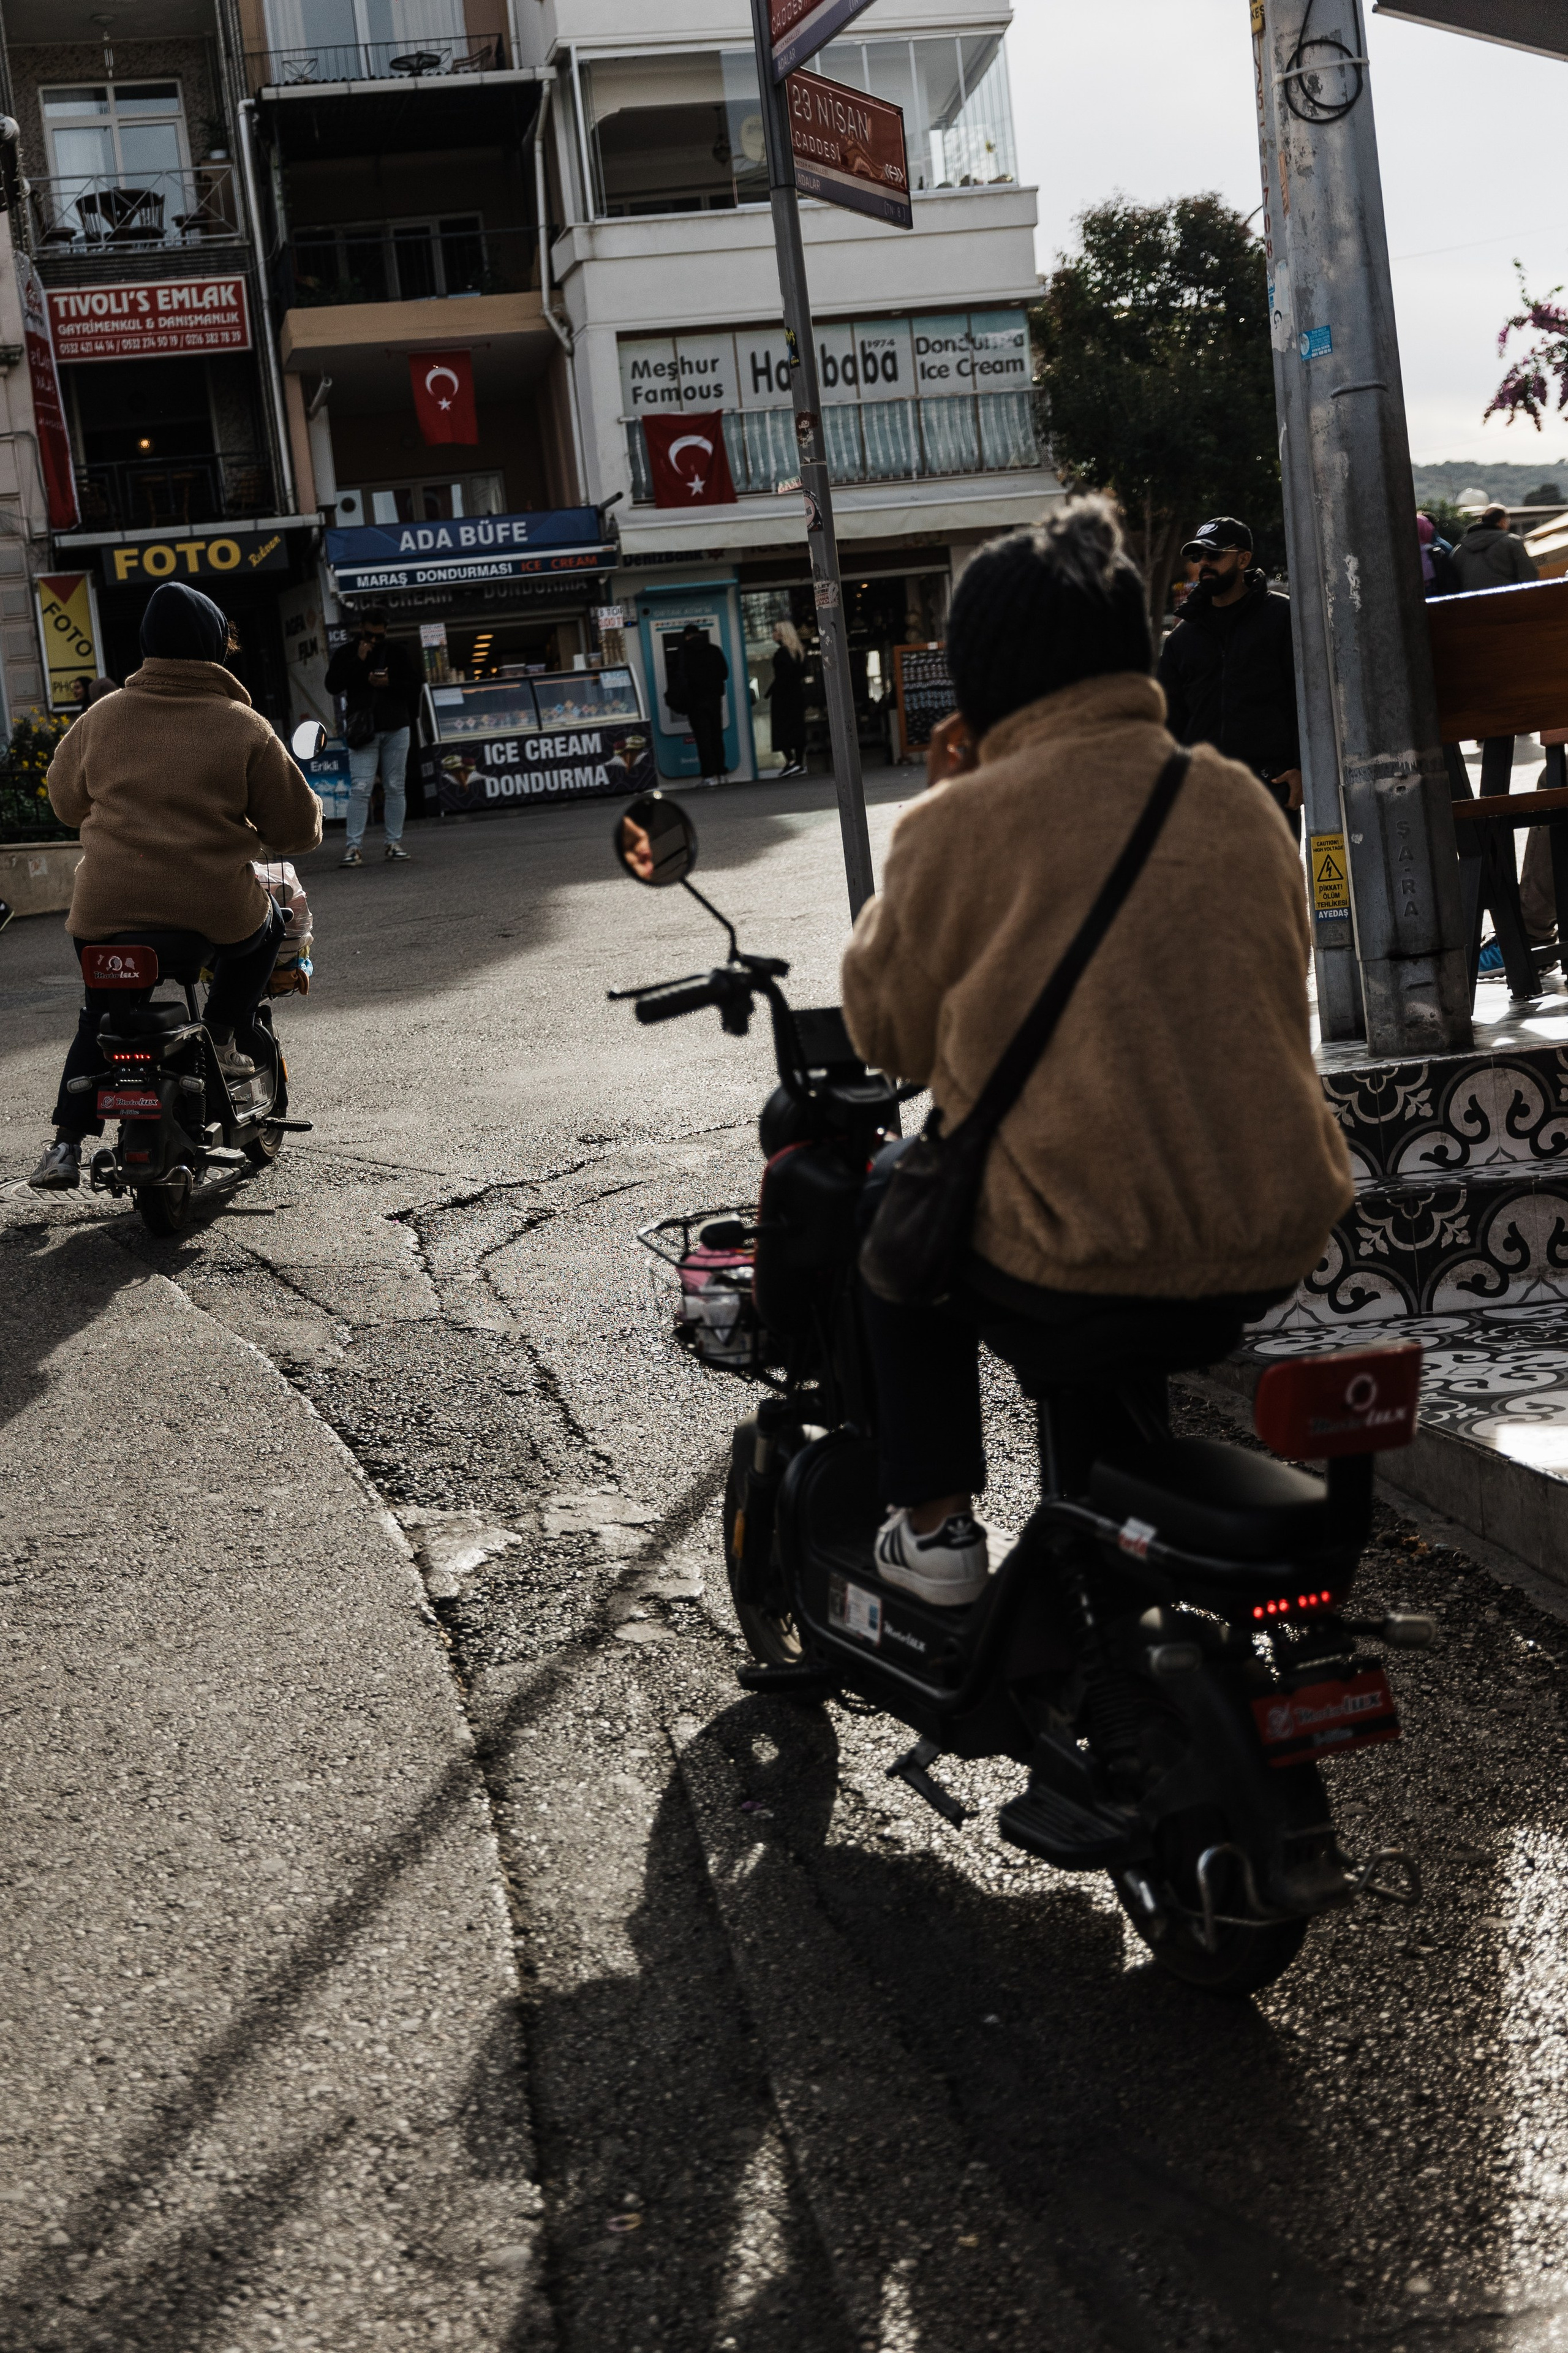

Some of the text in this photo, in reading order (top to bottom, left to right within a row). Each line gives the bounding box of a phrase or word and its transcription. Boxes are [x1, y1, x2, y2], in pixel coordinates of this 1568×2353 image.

[777, 47, 796, 72] ADALAR
[792, 85, 870, 145] 23 NİSAN
[796, 130, 842, 164] CADDESİ
[797, 173, 821, 191] ADALAR
[53, 289, 151, 319] TIVOLI'S
[156, 284, 238, 311] EMLAK
[57, 317, 143, 336] GAYRİMENKUL
[157, 311, 239, 327] DANIŞMANLIK
[631, 355, 720, 380] Meşhur
[921, 357, 1025, 380] Ice Cream
[632, 382, 724, 404] Famous
[399, 520, 529, 552] ADA BÜFE
[112, 538, 242, 581] FOTO
[356, 554, 598, 589] MARAŞ DONDURMASI ICE CREAM
[43, 601, 92, 657] FOTO
[484, 733, 603, 766] ICE CREAM
[310, 760, 340, 774] Erikli
[484, 765, 611, 799] DONDURMA
[1319, 884, 1343, 893] DİKKAT!
[1317, 898, 1348, 908] TEHLİKESİ
[1319, 908, 1349, 918] AYEDAŞ
